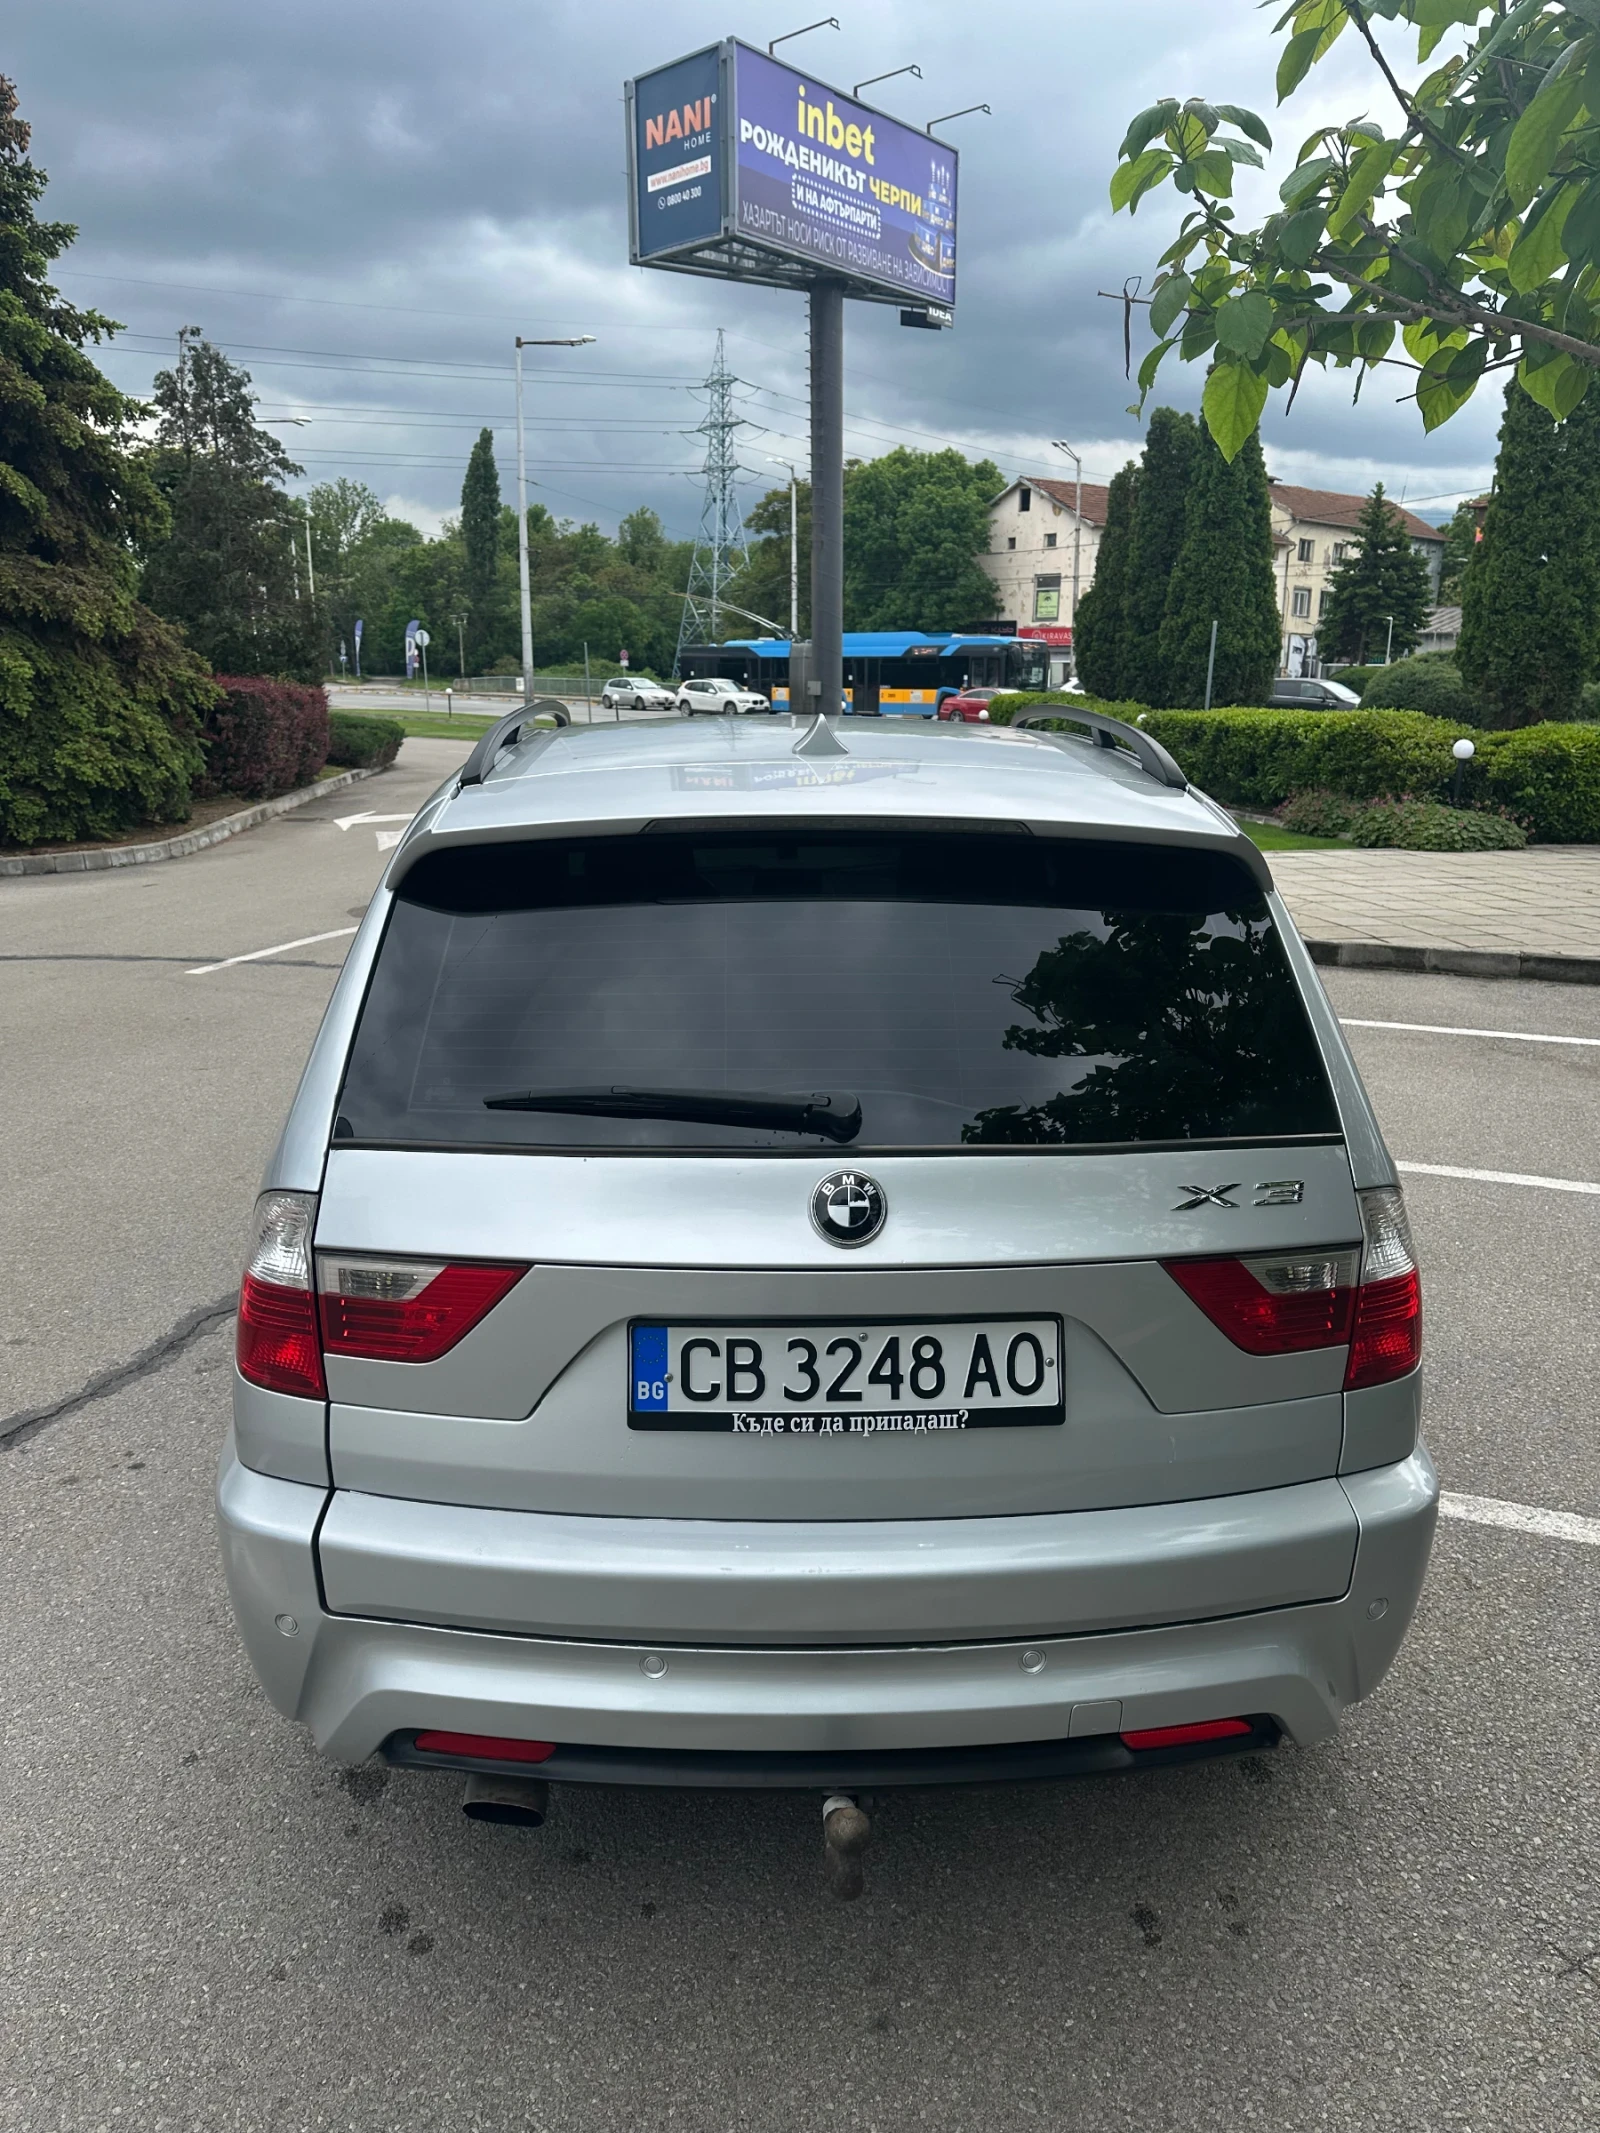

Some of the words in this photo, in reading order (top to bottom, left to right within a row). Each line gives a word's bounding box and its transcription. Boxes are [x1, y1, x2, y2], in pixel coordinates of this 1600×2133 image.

[646, 96, 711, 150] NANI
[683, 132, 711, 151] HOME
[798, 84, 875, 166] inbet
[740, 118, 866, 193] РОЖДЕНИКЪТ
[869, 176, 922, 217] ЧЕРПИ
[666, 192, 681, 207] 0800
[682, 189, 690, 201] 40
[797, 184, 804, 202] И
[805, 187, 819, 208] НА
[820, 194, 878, 231] АФТЪРПАРТИ
[742, 200, 786, 236] ХАЗАРТЪТ
[788, 218, 811, 247] НОСИ
[814, 227, 835, 255] РИСК
[836, 236, 847, 260] ОТ
[848, 240, 892, 274] РАЗВИВАНЕ
[929, 307, 952, 321] IDEA
[821, 1174, 877, 1196] BMW
[783, 1334, 946, 1403] 3248
[637, 1381, 664, 1400] BG
[732, 1413, 784, 1437] Къде
[790, 1417, 815, 1434] си
[819, 1417, 844, 1436] да
[849, 1410, 970, 1437] припадаш?
